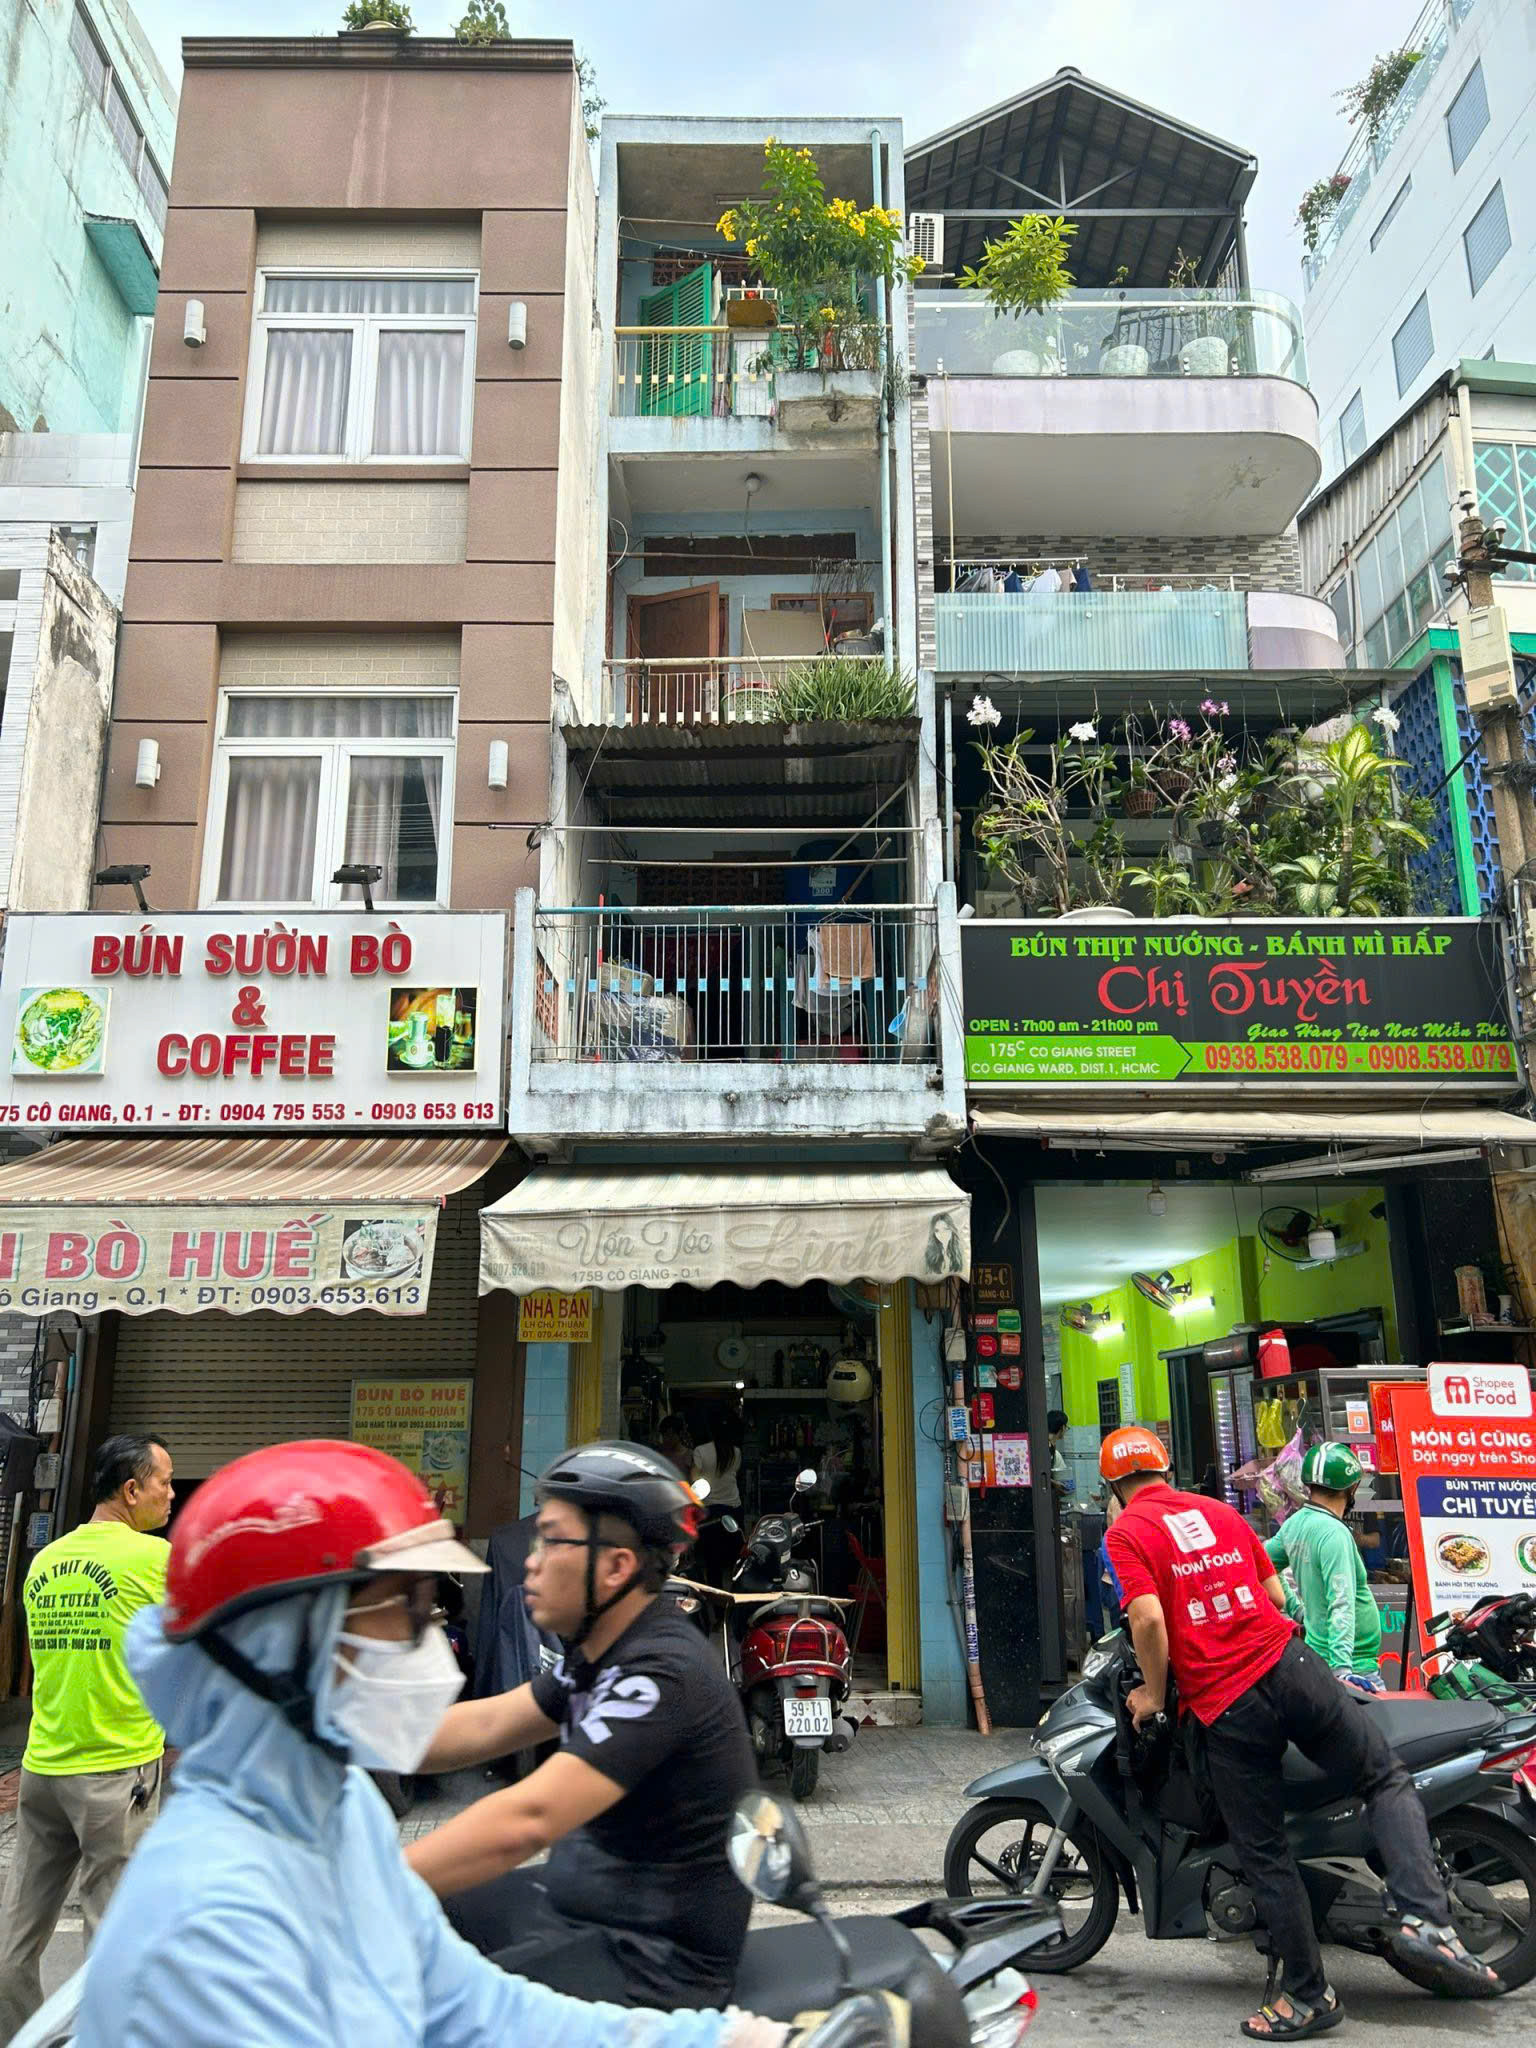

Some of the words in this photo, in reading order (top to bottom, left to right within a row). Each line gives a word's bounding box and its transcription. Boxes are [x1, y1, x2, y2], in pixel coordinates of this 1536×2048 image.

[91, 924, 184, 976] BÚN
[204, 922, 328, 976] SƯỜN
[350, 922, 412, 975] BÒ
[1010, 931, 1068, 957] BÚN
[1073, 936, 1137, 962] THỊT
[1144, 929, 1244, 957] NƯỚNG
[1266, 930, 1346, 956] BÁNH
[1352, 930, 1386, 956] MÌ
[1391, 926, 1452, 956] HẤP
[1097, 965, 1189, 1016] Chị
[1208, 957, 1372, 1022] Tuyền
[232, 985, 267, 1028] &
[969, 1019, 1010, 1032] OPEN
[1021, 1019, 1055, 1032] 7h00
[1058, 1021, 1079, 1032] am
[1091, 1019, 1132, 1032] 21h00
[1136, 1021, 1158, 1034] pm
[1247, 1023, 1289, 1042] Giao
[1294, 1023, 1343, 1042] Hàng
[1347, 1022, 1380, 1041] Tận
[1384, 1023, 1419, 1038] Nơi
[1422, 1021, 1472, 1038] Miễn
[157, 1033, 336, 1077] COFFEE
[1029, 1046, 1048, 1057] CO
[1051, 1046, 1093, 1057] GIANG
[1096, 1046, 1137, 1057] STREET
[1205, 1044, 1348, 1071] 0938.538.079
[1368, 1044, 1511, 1070] 0908.538.079
[971, 1063, 990, 1074] CO
[993, 1063, 1035, 1074] GIANG
[1037, 1063, 1077, 1075] WARD,
[1122, 1063, 1160, 1074] HCMC
[27, 1101, 51, 1121] CÔ
[59, 1104, 118, 1124] GIANG,
[123, 1104, 153, 1122] Q.1
[179, 1104, 210, 1121] ĐT:
[220, 1104, 265, 1120] 0904
[273, 1103, 305, 1120] 795
[312, 1103, 345, 1119] 553
[371, 1103, 416, 1119] 0903
[423, 1103, 456, 1119] 653
[464, 1103, 494, 1119] 613
[45, 1219, 145, 1282] BÒ
[169, 1213, 332, 1281] HUẾ
[641, 1219, 713, 1264] Tóc
[571, 1271, 604, 1283] 175B
[607, 1268, 625, 1281] CÔ
[629, 1269, 670, 1280] GIANG
[681, 1268, 700, 1280] Q.1
[21, 1288, 99, 1310] Giang
[126, 1288, 166, 1305] Q.1
[198, 1287, 240, 1304] ĐT:
[251, 1287, 420, 1305] 0903.653.613
[523, 1292, 554, 1318] NHÀ
[559, 1292, 589, 1318] BÁN
[1473, 1377, 1515, 1389] Shopee
[1475, 1390, 1517, 1405] Food
[1411, 1427, 1452, 1445] MÓN
[1458, 1428, 1475, 1446] GÌ
[1481, 1429, 1532, 1447] CŨNG
[1413, 1450, 1437, 1463] Đặt
[1442, 1453, 1475, 1466] ngay
[1480, 1452, 1507, 1463] trên
[1446, 1479, 1468, 1490] BÚN
[1471, 1480, 1496, 1493] THỊT
[1442, 1497, 1477, 1517] CHỊ
[52, 1559, 82, 1578] THỊT
[1172, 1548, 1243, 1577] NowFood
[788, 1717, 829, 1734] 220.02
